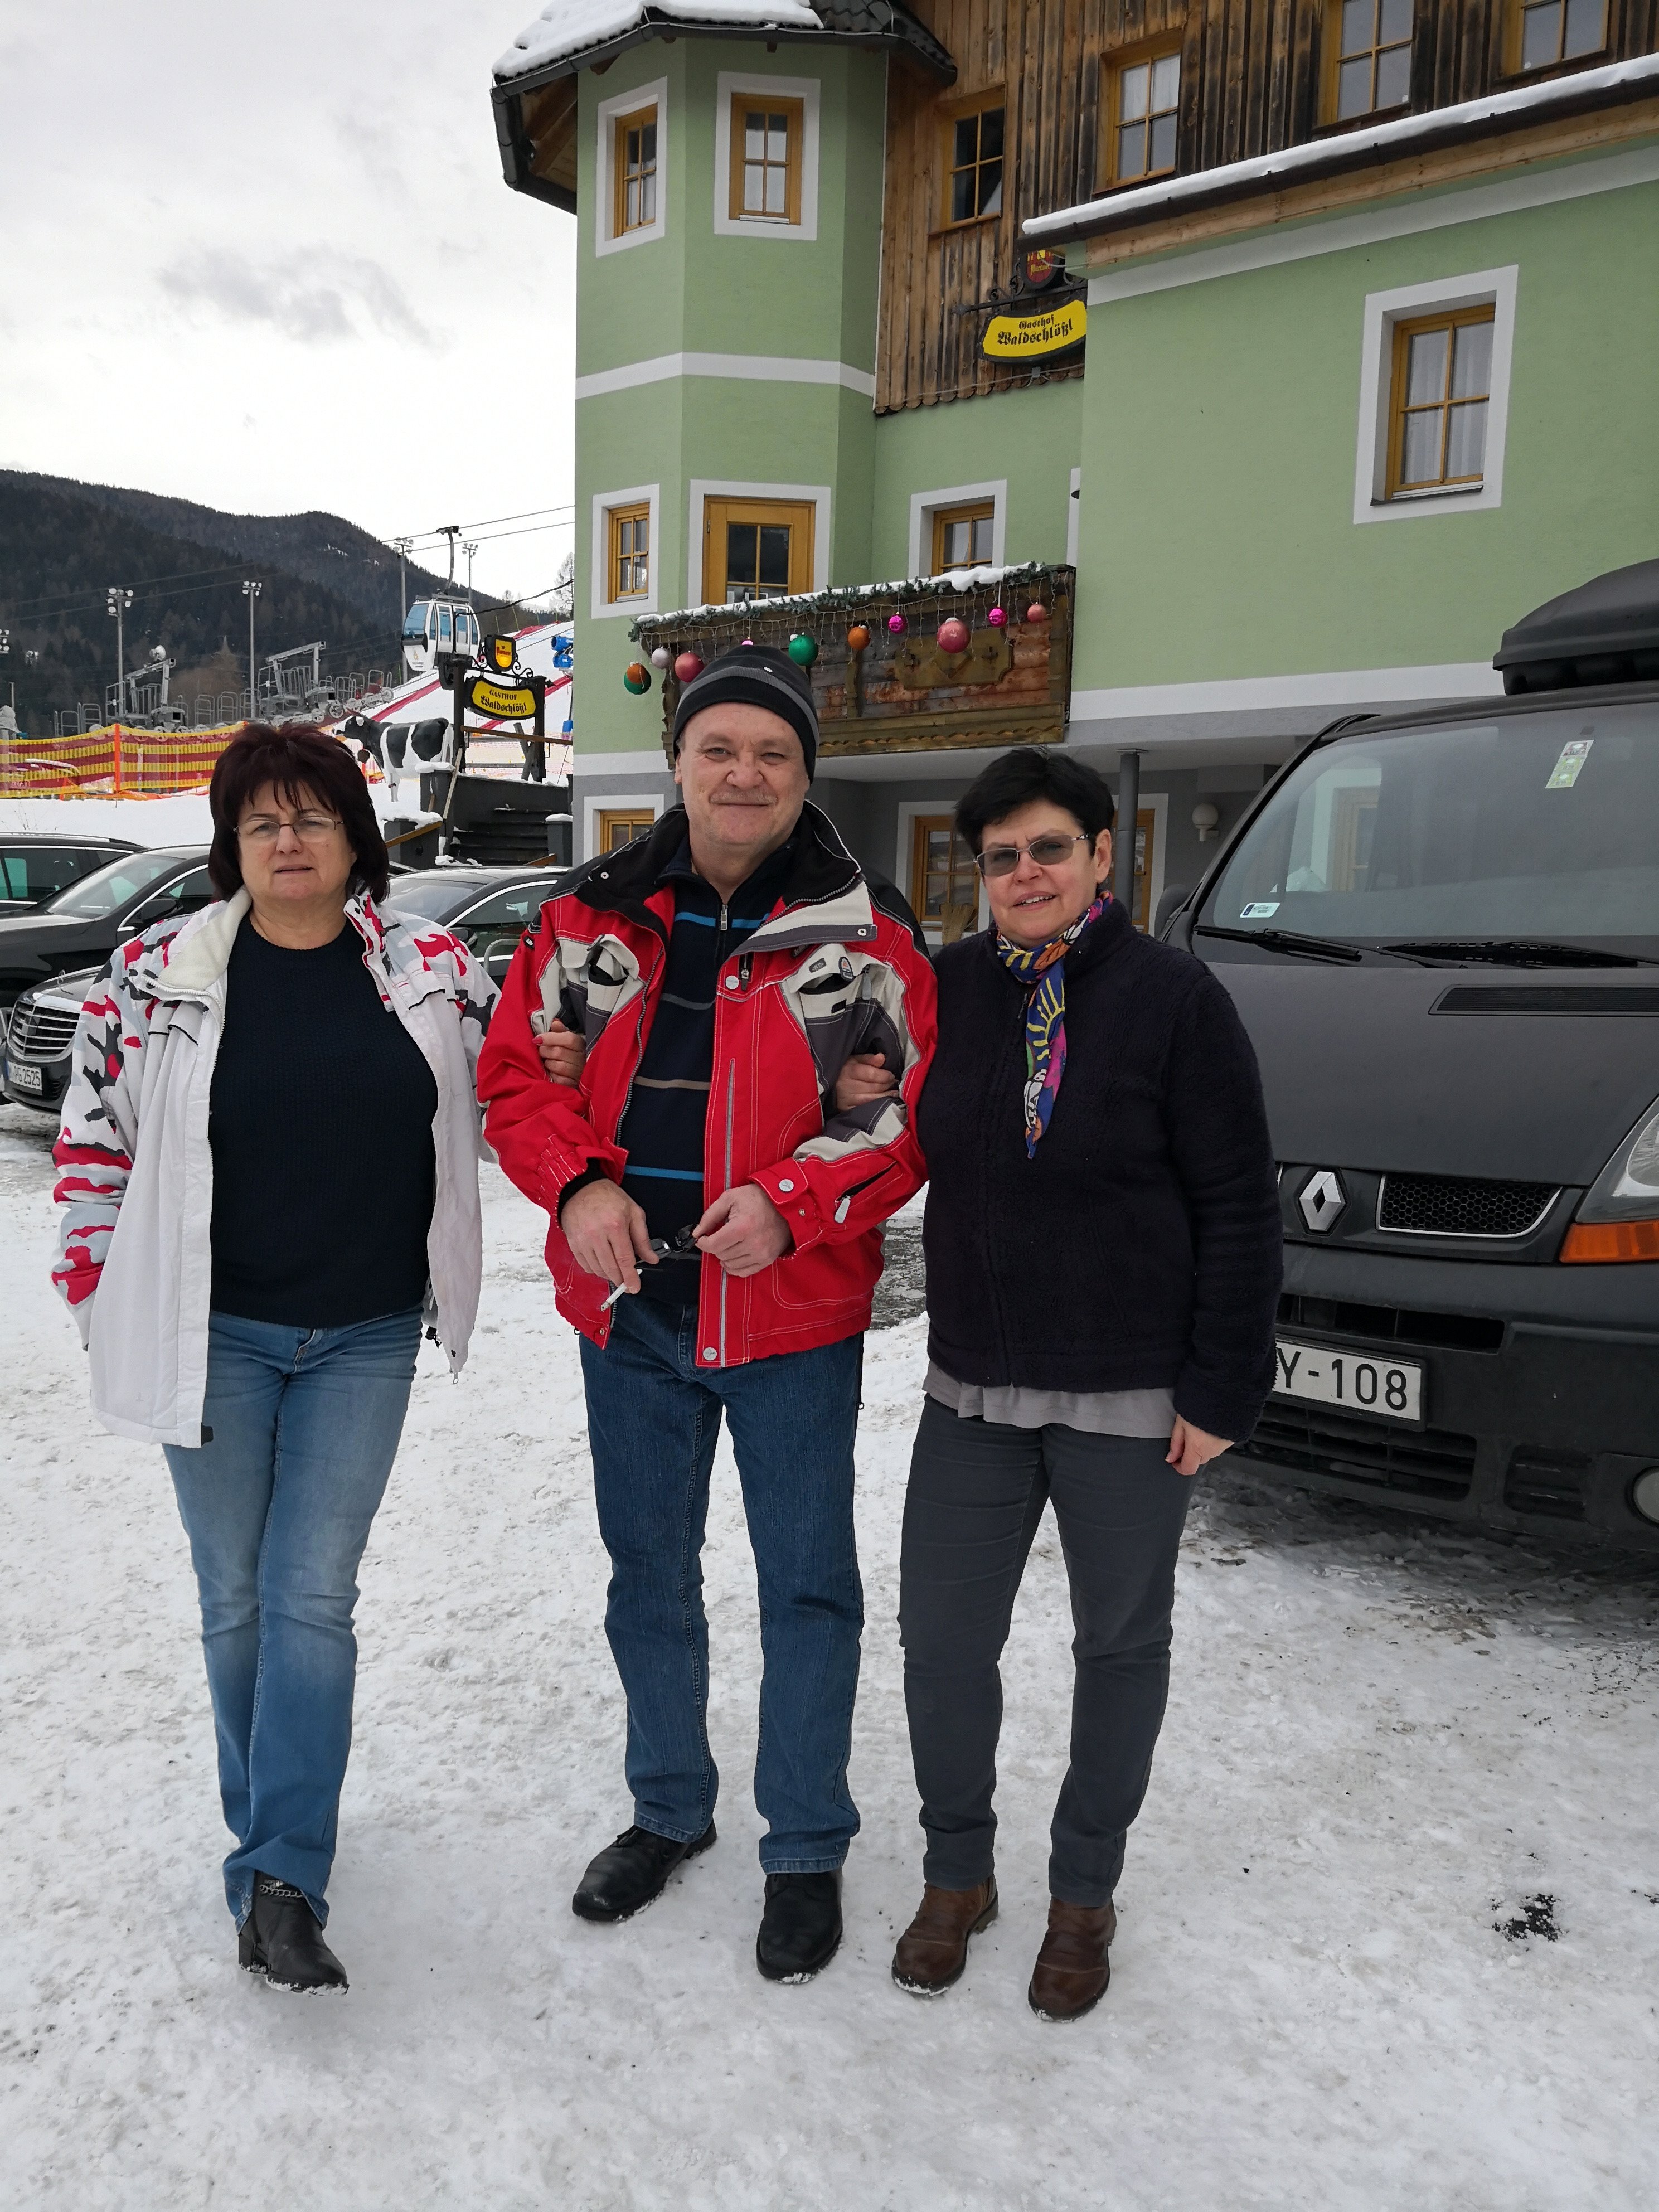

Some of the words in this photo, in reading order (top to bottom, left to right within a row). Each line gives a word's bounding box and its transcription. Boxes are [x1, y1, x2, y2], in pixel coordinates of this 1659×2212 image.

[1019, 314, 1054, 329] Gasthof
[997, 318, 1073, 345] Waldschlößl
[489, 690, 517, 700] GASTHOF
[481, 695, 527, 714] Waldschlößl
[23, 1069, 41, 1086] 2525
[1276, 1347, 1407, 1411] Y-108
